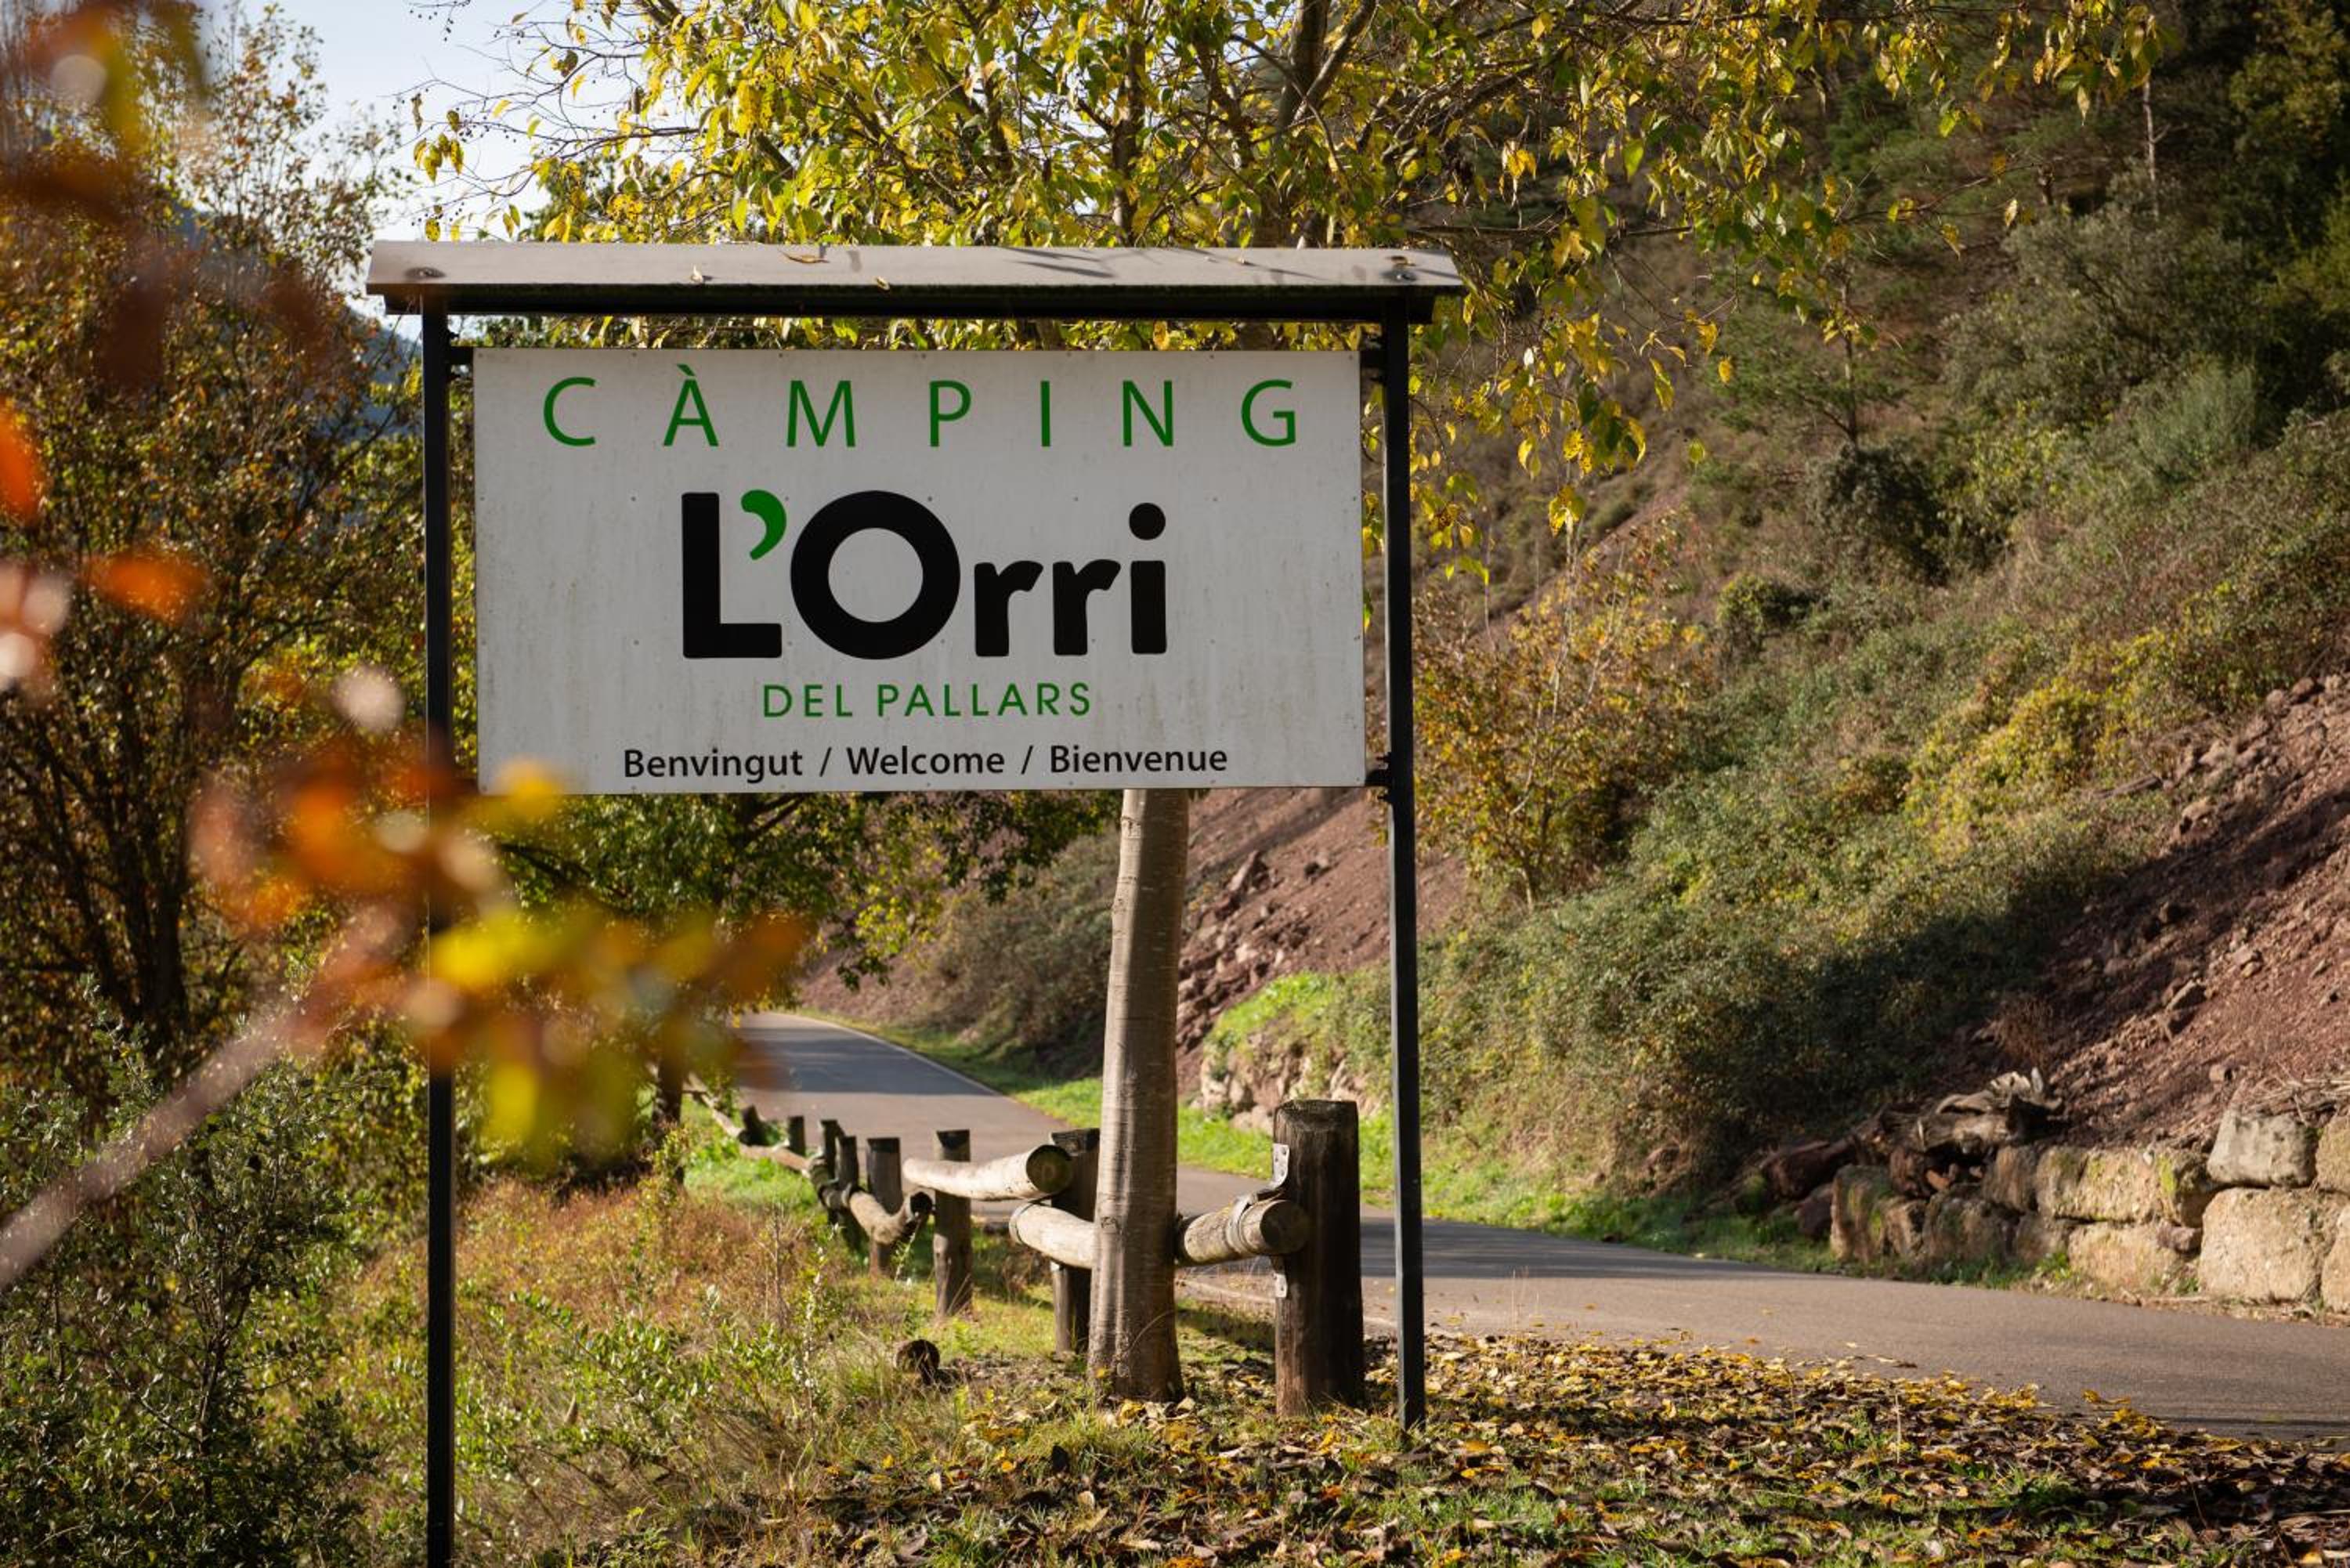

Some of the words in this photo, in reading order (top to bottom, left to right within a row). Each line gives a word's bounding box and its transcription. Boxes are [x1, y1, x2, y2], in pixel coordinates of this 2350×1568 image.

[543, 363, 1297, 448] CÀMPING
[763, 684, 853, 718] DEL
[877, 681, 1091, 717] PALLARS
[624, 746, 803, 785] Benvingut
[846, 746, 1005, 775] Welcome
[1050, 744, 1228, 774] Bienvenue
